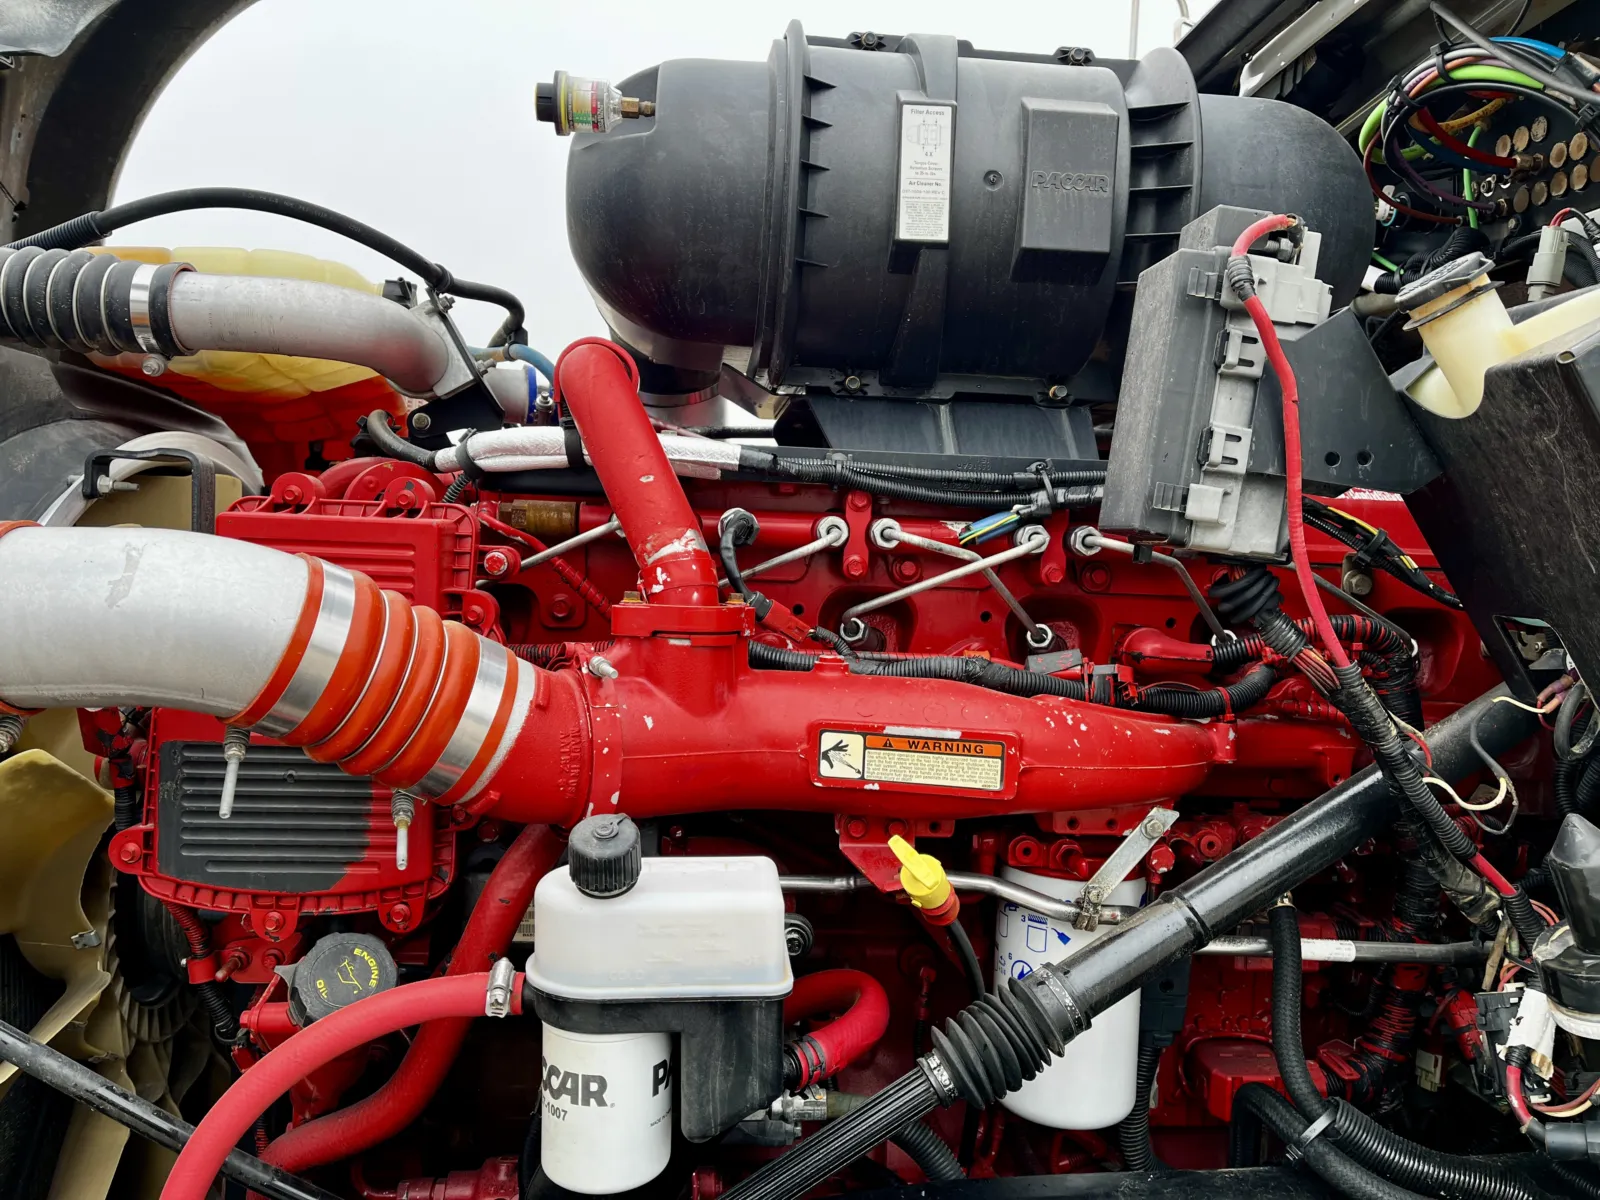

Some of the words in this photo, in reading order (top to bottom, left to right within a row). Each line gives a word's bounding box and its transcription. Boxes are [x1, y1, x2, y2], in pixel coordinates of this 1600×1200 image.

[1031, 170, 1109, 192] PACCAR
[908, 740, 984, 754] WARNING
[1021, 914, 1026, 922] 3
[1008, 952, 1013, 960] 6
[353, 947, 379, 988] ENGINE
[316, 979, 328, 999] OIL
